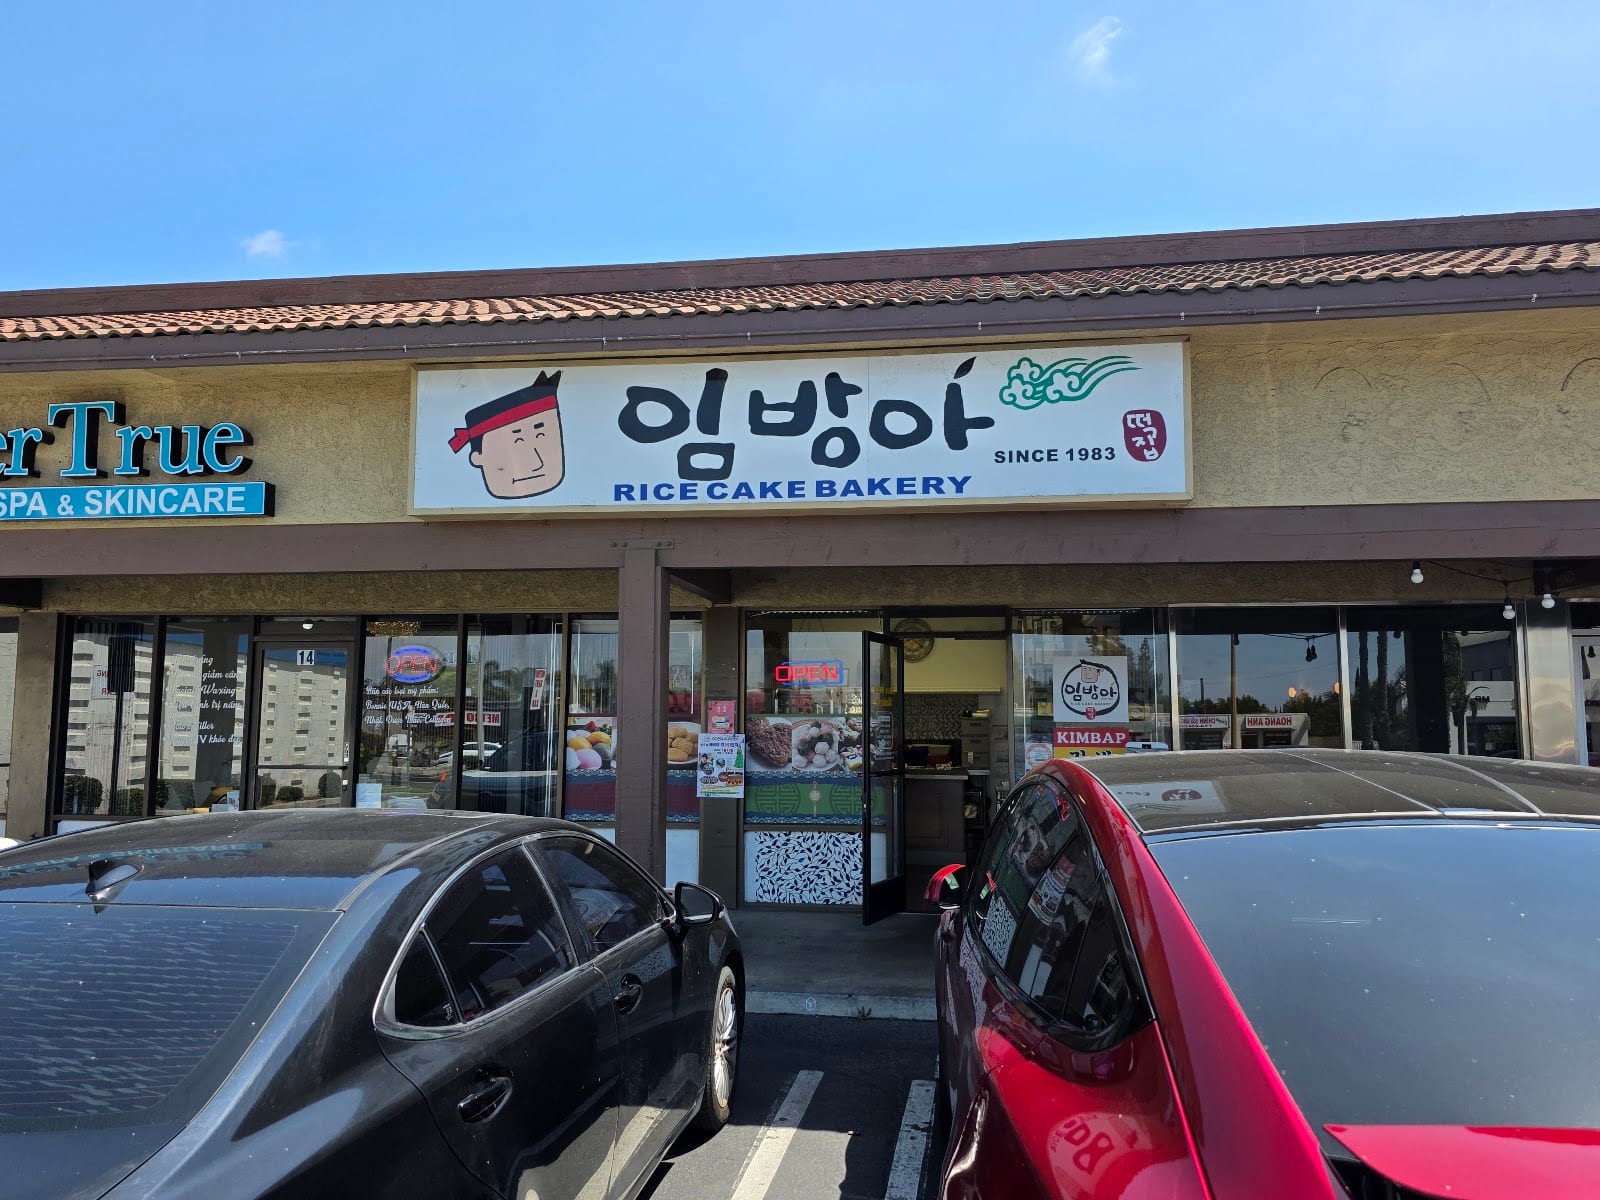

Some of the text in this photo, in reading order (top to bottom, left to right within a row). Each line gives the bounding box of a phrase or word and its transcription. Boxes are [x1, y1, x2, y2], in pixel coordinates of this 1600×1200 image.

[618, 362, 995, 481] 임방아
[0, 401, 244, 476] r True
[994, 447, 1116, 464] SINCE 1983
[614, 475, 973, 501] RICE CAKE BAKERY
[57, 494, 75, 516] &
[84, 487, 246, 515] SKINCARE
[299, 650, 314, 665] 14
[385, 655, 439, 675] OPEN
[774, 664, 839, 682] OPEN
[1065, 682, 1117, 702] 임방아
[1057, 731, 1126, 744] KIMBAP
